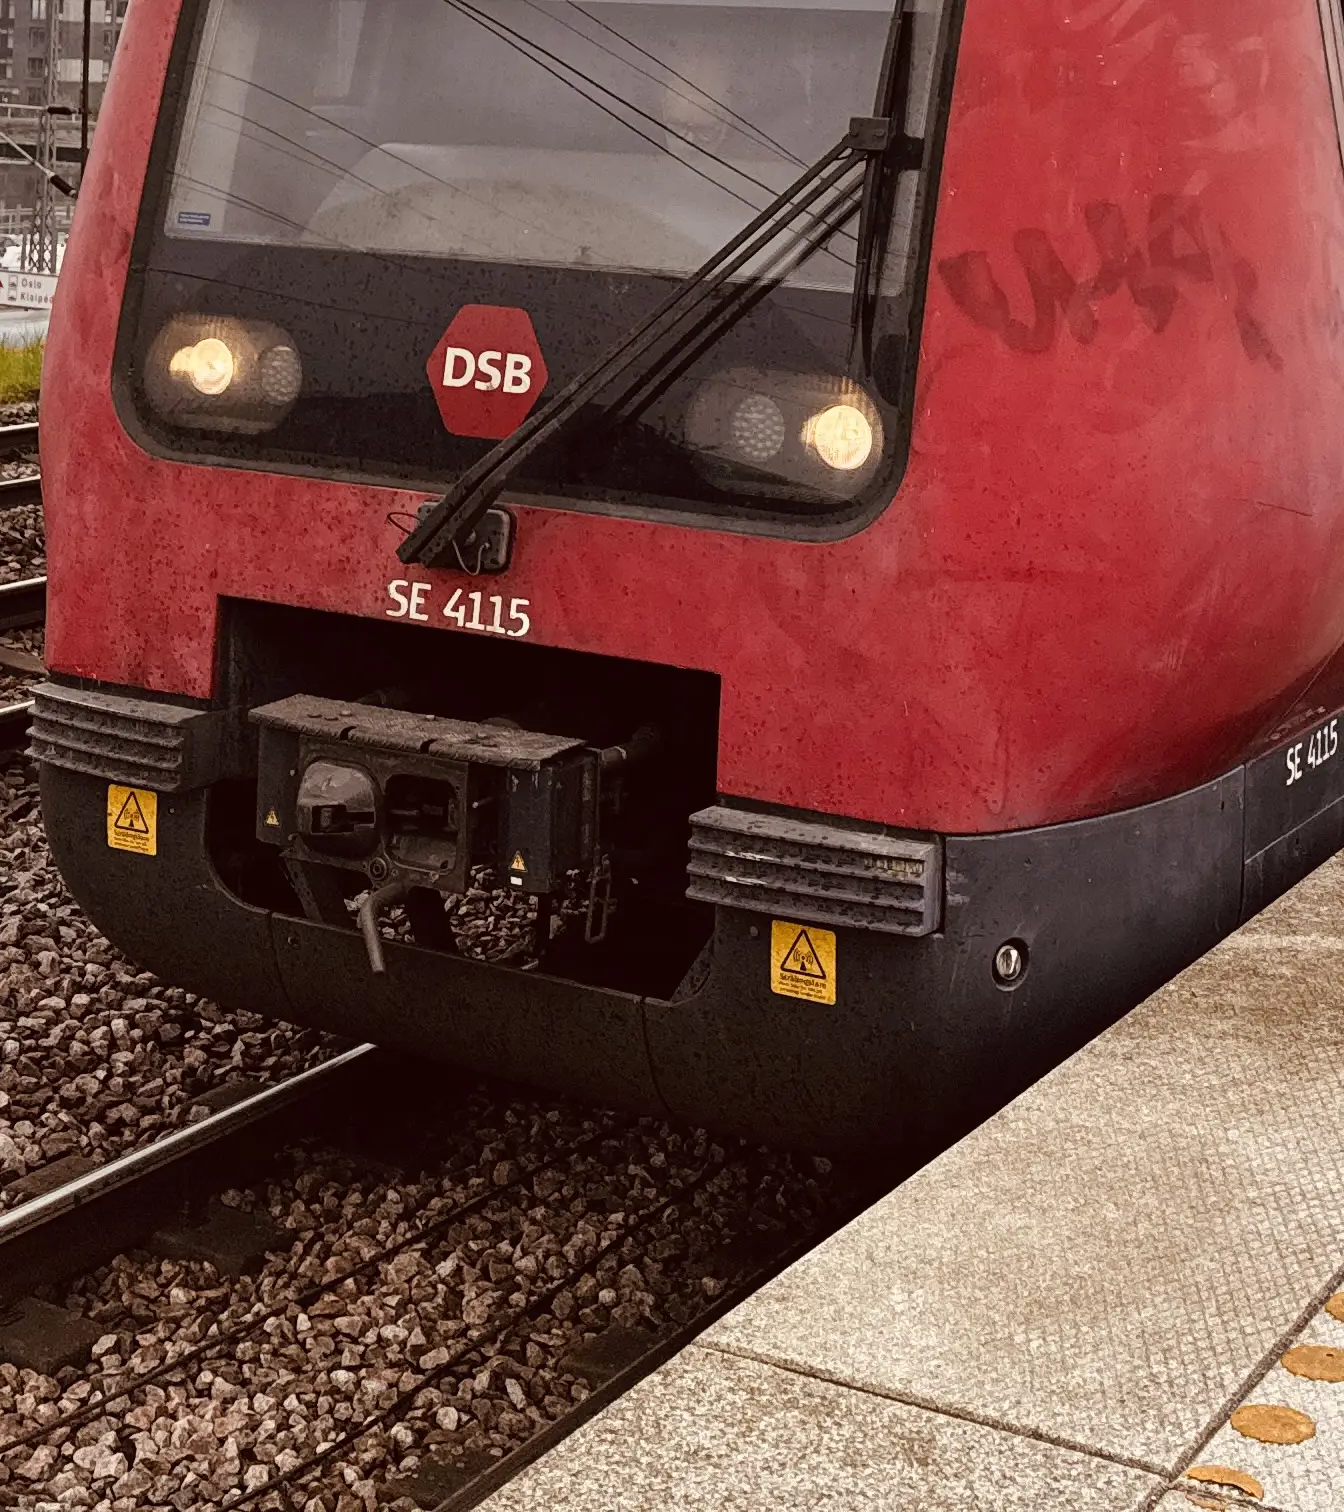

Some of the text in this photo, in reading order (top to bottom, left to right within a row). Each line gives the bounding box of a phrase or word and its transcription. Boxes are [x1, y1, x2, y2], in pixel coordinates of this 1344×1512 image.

[21, 277, 42, 290] Oslo
[443, 347, 532, 394] DSB
[386, 580, 530, 637] SE 4115
[1285, 718, 1337, 786] SE 4115
